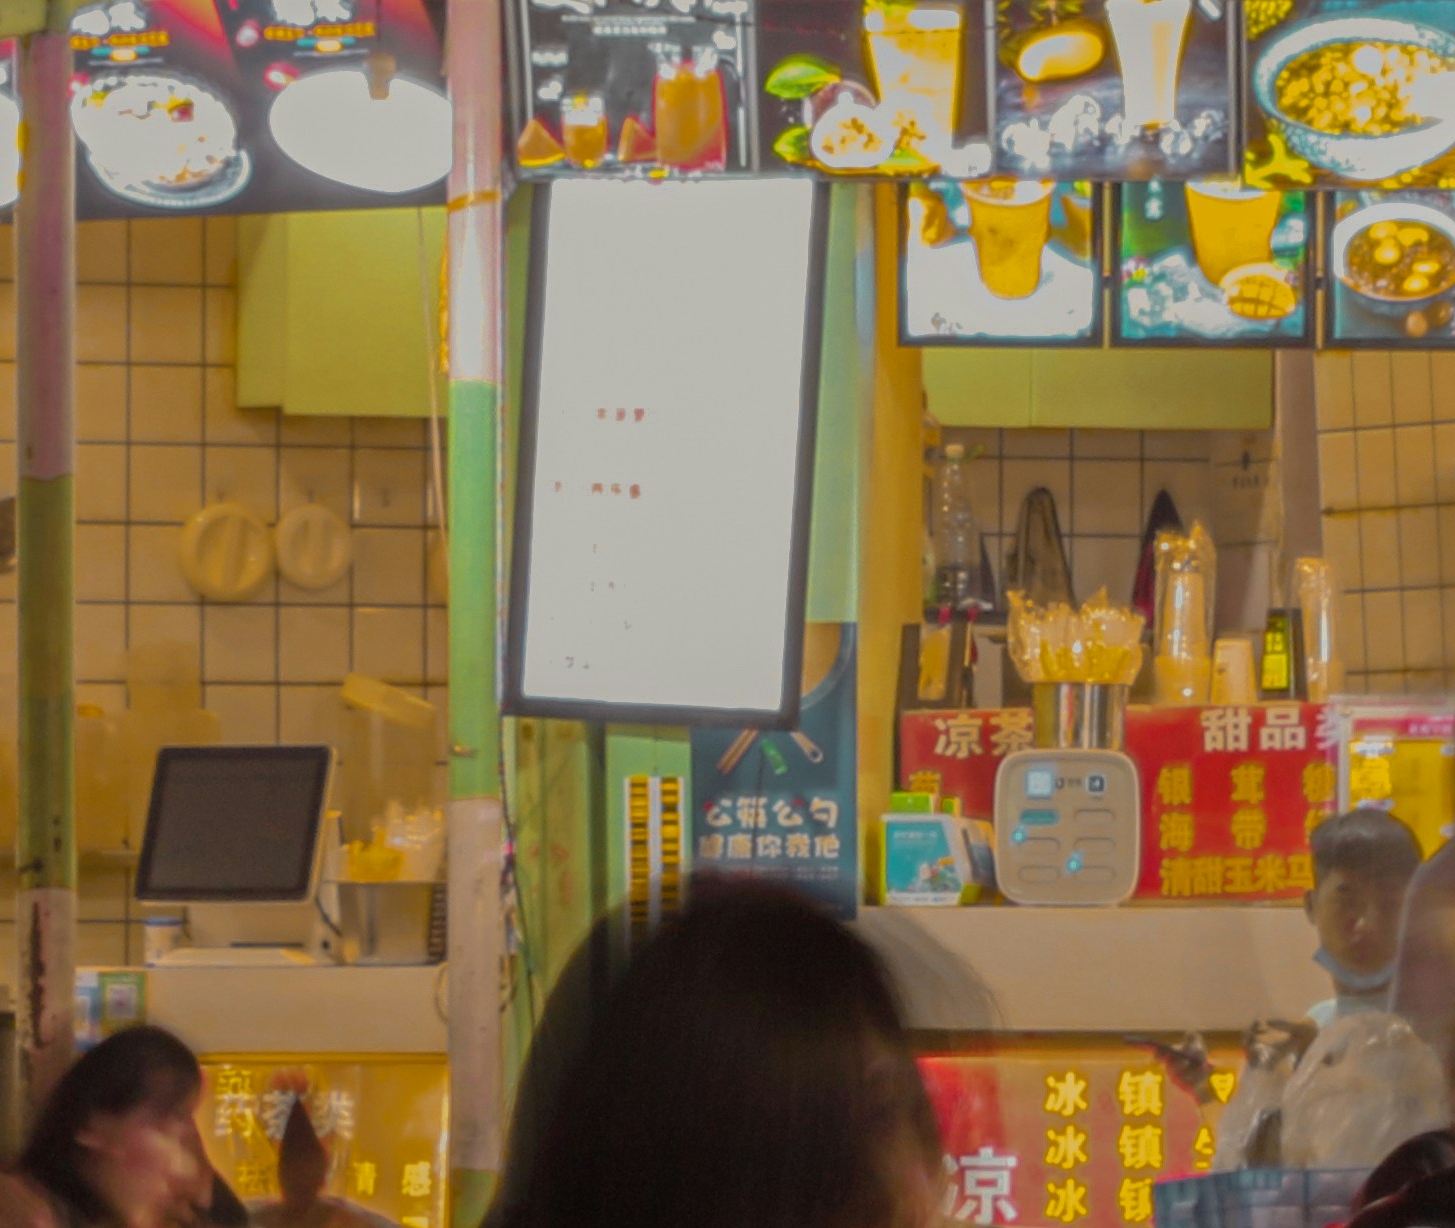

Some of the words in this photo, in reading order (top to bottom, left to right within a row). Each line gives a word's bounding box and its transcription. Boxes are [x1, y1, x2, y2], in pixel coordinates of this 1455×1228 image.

[934, 712, 1035, 759] 凉茶
[702, 796, 839, 829] 公筷公勺
